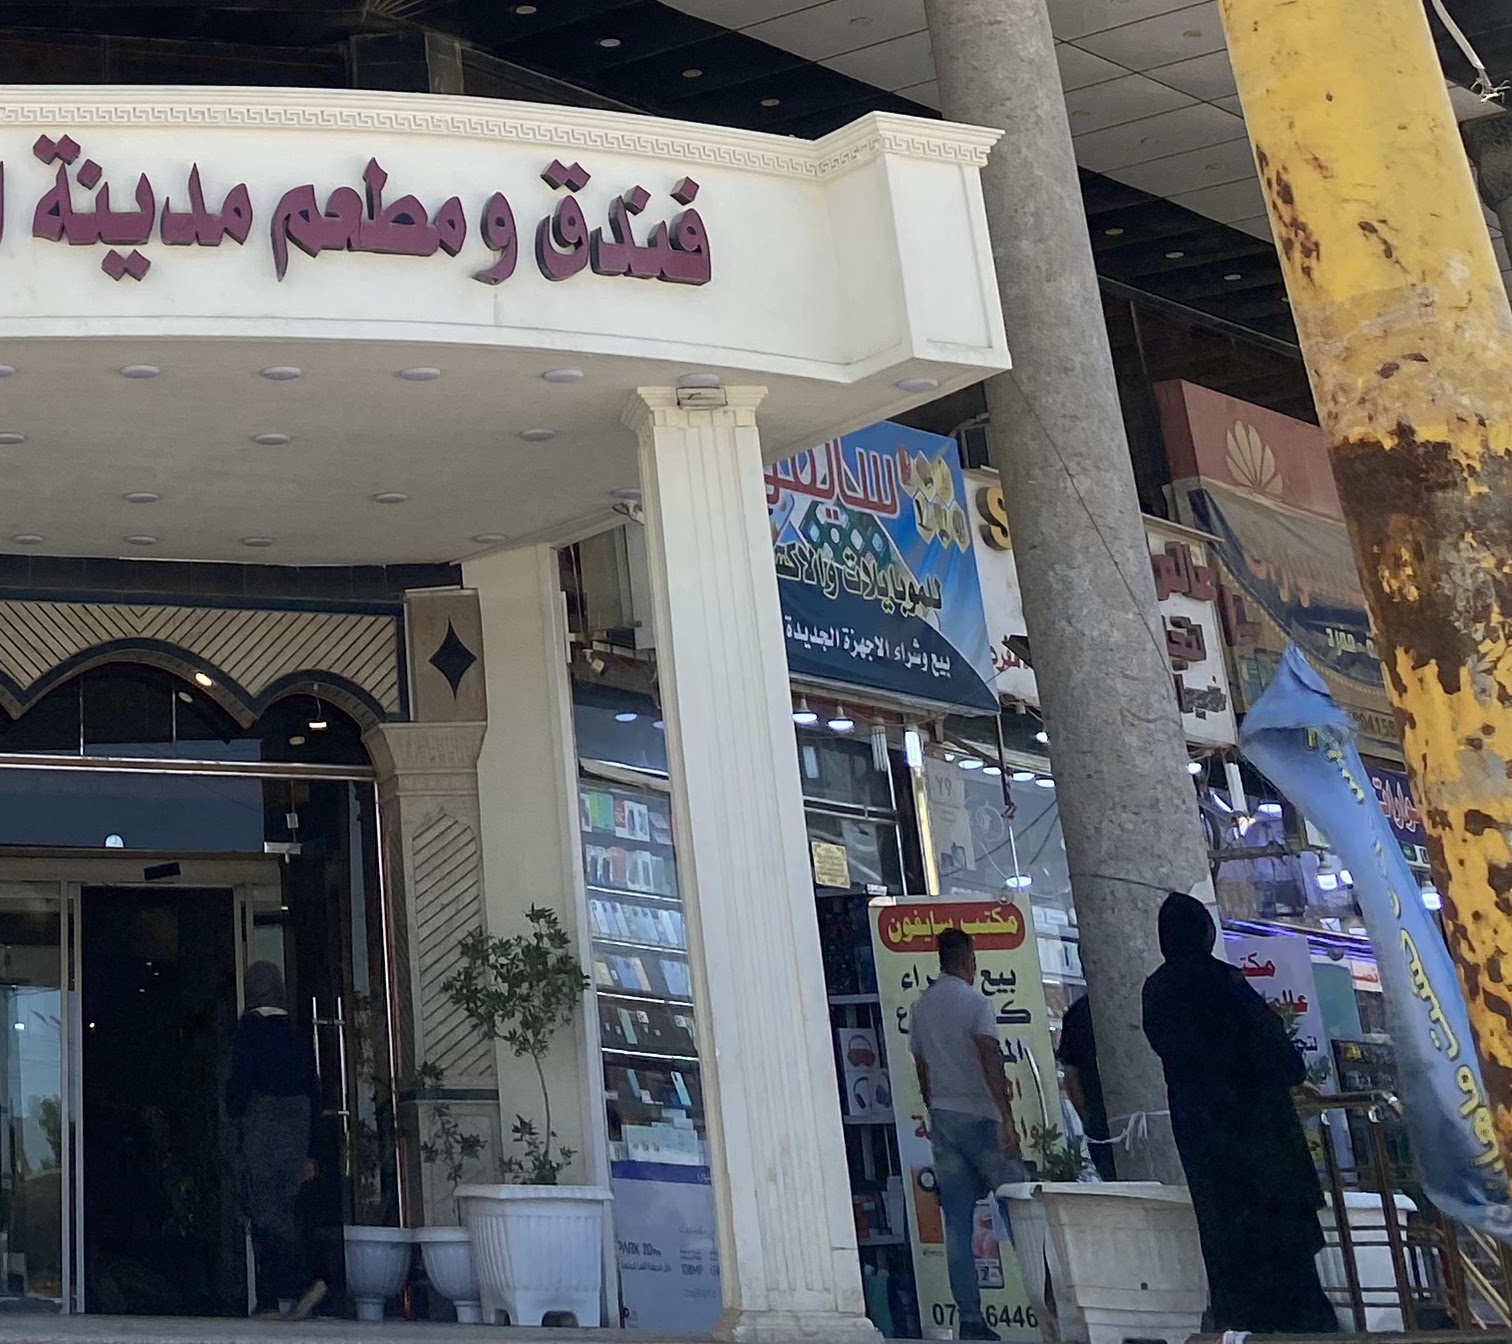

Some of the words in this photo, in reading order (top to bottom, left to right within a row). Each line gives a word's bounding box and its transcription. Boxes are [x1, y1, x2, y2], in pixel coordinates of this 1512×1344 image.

[32, 134, 254, 281] مدينة
[534, 158, 712, 287] فندق
[784, 614, 840, 653] الجديدة
[894, 637, 928, 673] وشراء
[930, 652, 952, 679] بيع
[960, 907, 1019, 939] مكتب
[1239, 951, 1277, 978] مكت
[980, 968, 1017, 996] بيع
